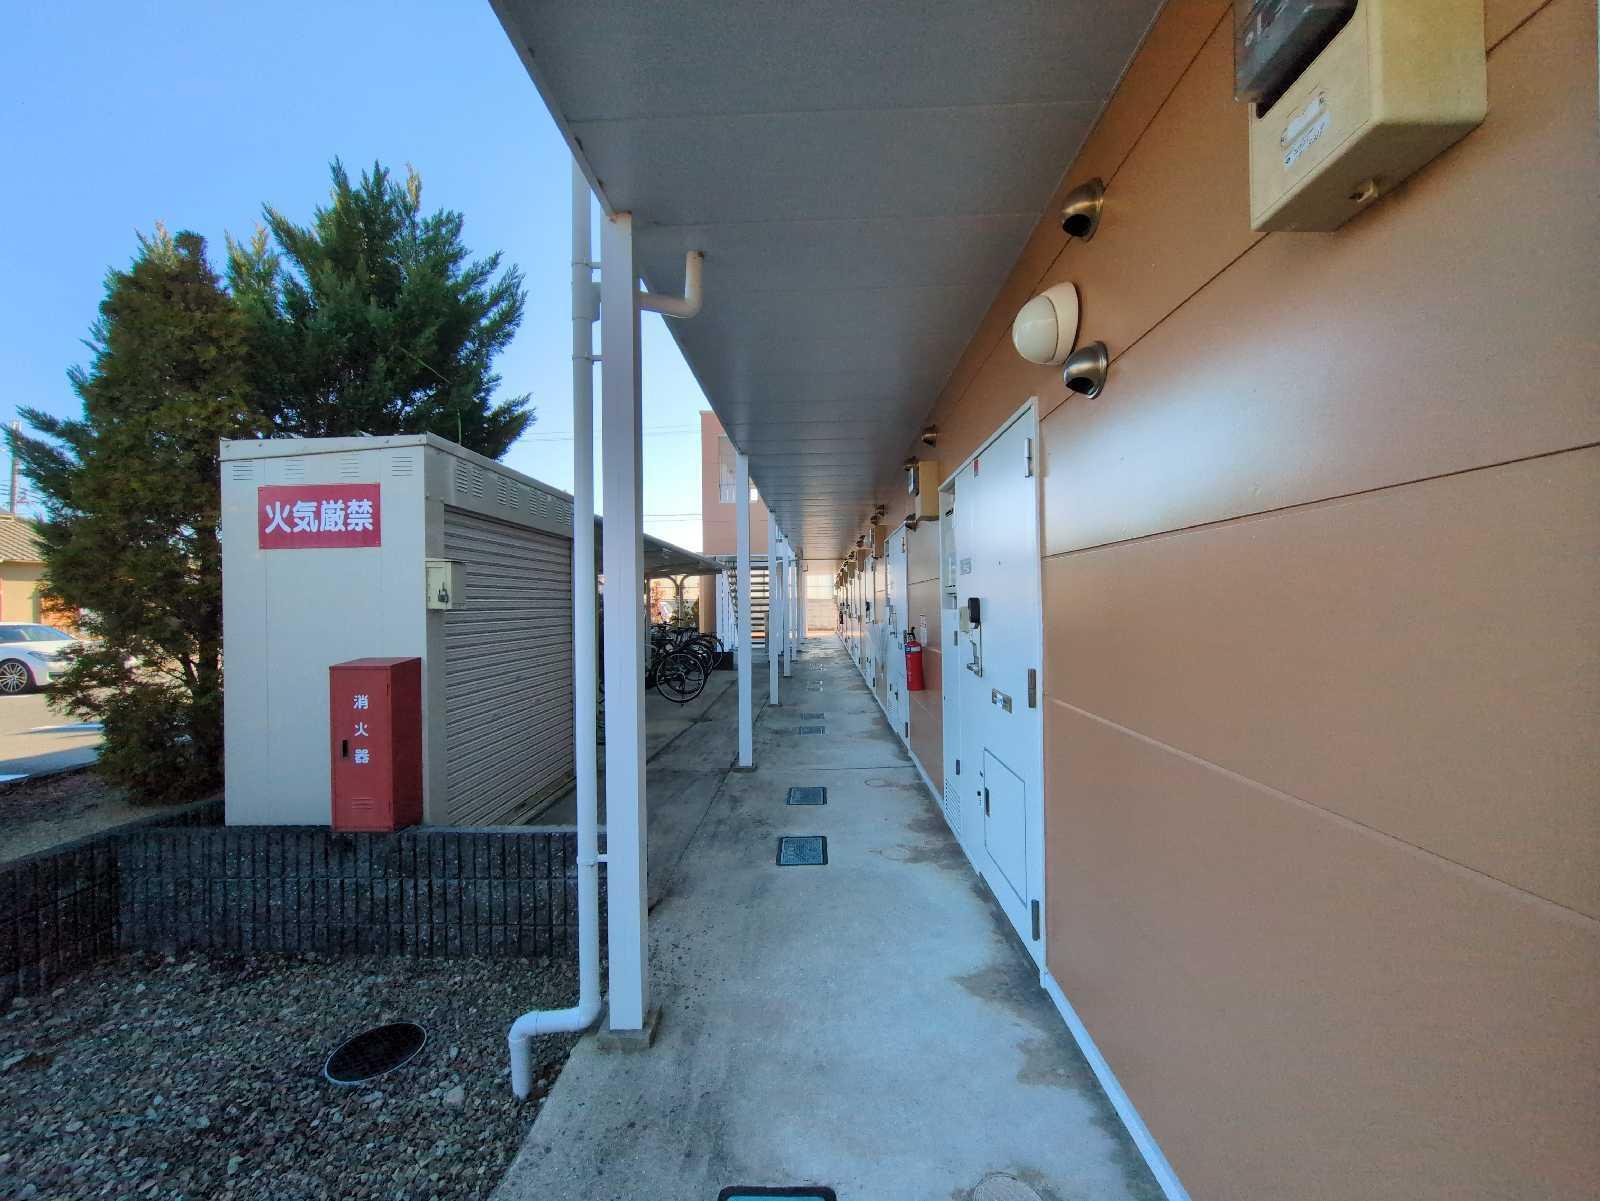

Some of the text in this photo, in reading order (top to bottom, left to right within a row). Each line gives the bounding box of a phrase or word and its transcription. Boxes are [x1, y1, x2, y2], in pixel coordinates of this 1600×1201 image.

[265, 499, 374, 534] 火気厳禁
[353, 694, 370, 764] 消火器
